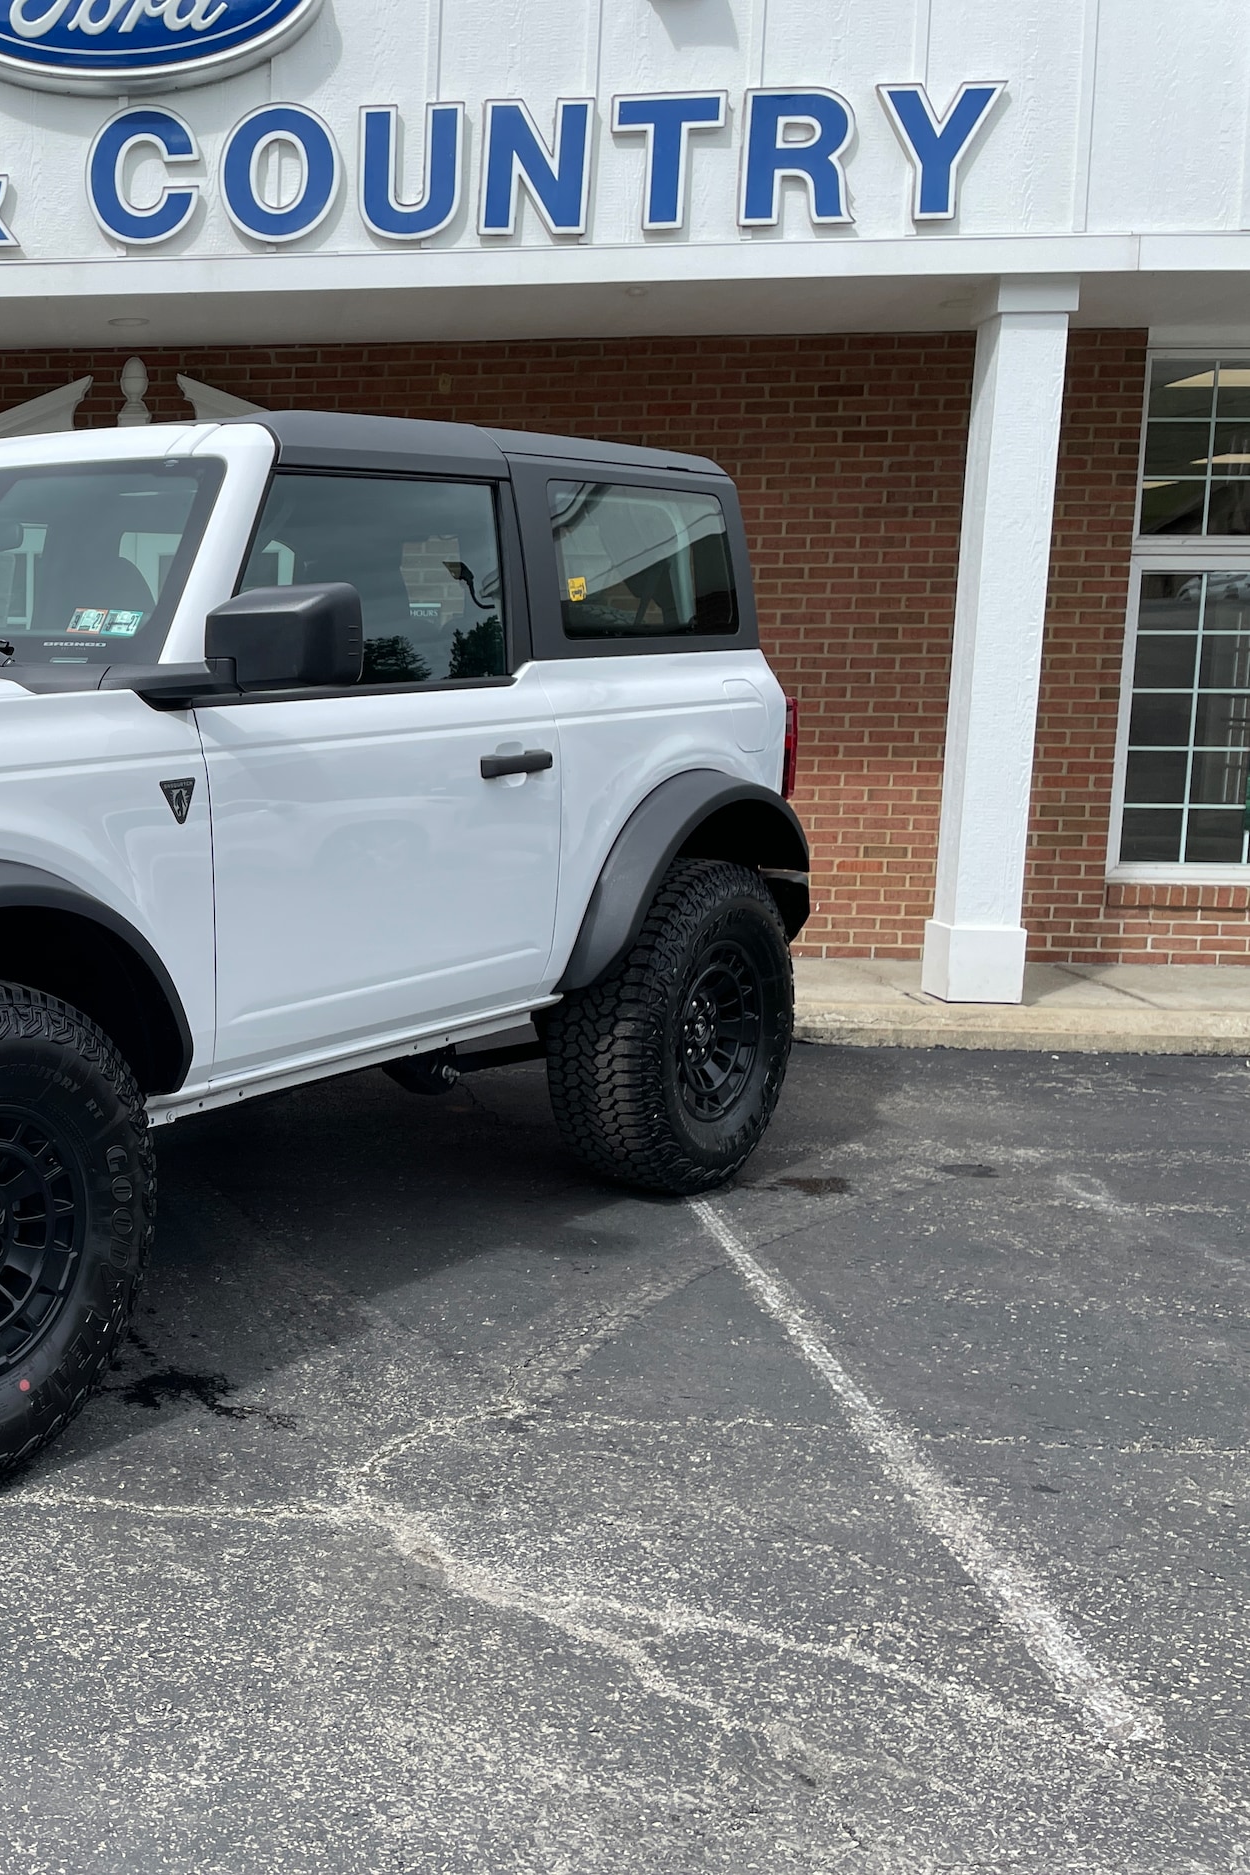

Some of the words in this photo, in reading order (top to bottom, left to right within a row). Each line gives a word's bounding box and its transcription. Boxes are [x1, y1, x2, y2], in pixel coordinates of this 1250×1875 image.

[86, 80, 1008, 246] COUNTRY
[410, 609, 439, 617] HOURS
[84, 1097, 105, 1121] RT
